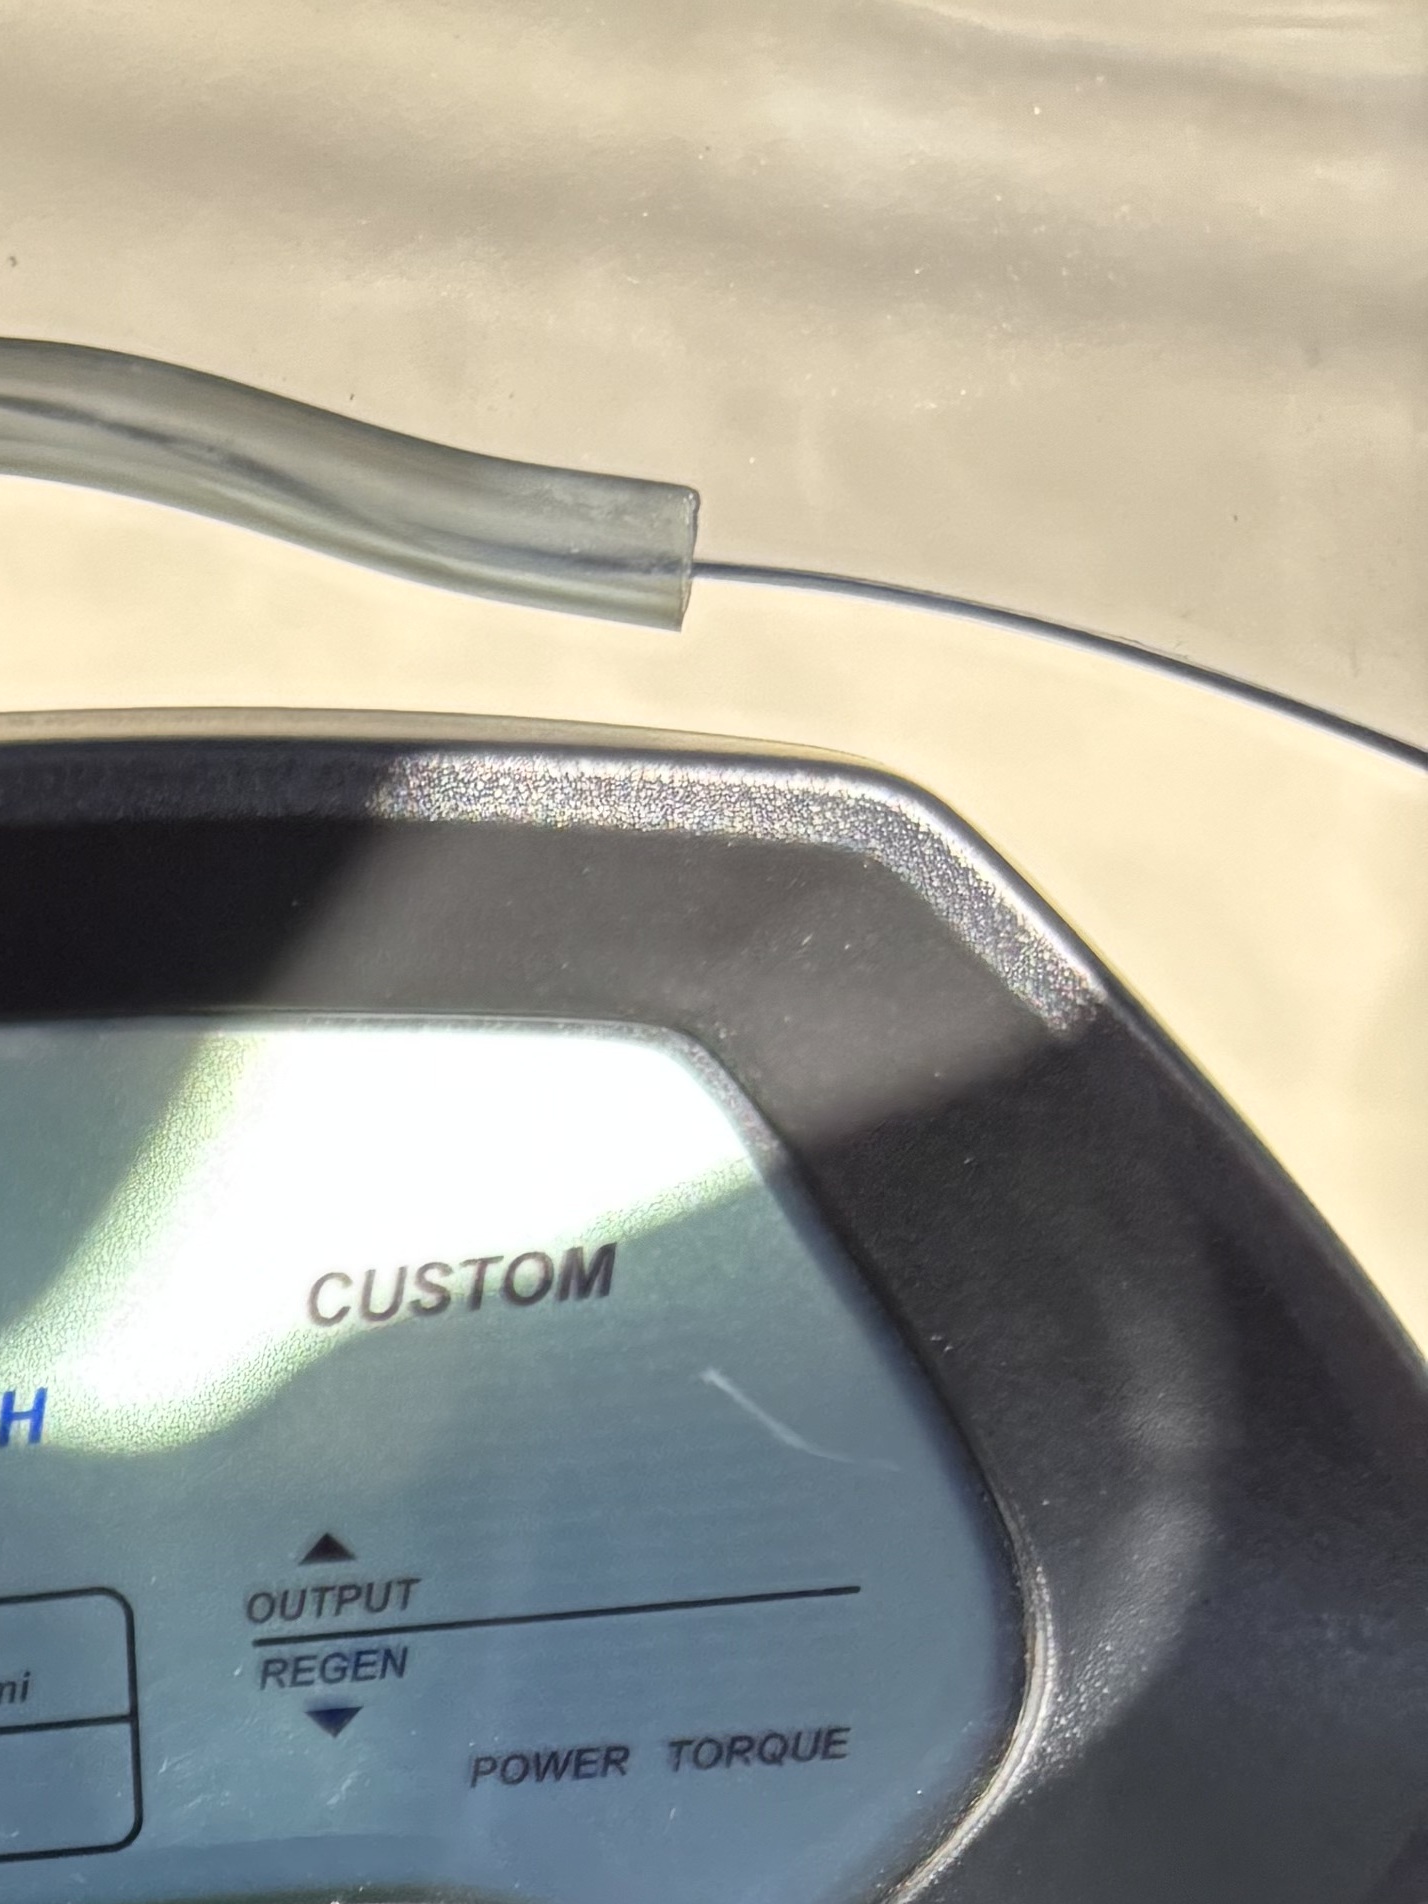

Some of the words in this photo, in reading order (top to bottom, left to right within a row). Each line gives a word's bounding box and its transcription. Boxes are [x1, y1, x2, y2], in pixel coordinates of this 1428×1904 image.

[306, 1242, 618, 1328] CUSTOM
[245, 1577, 422, 1626] OUTPUT
[259, 1646, 410, 1691] REGEN
[469, 1744, 632, 1789] POWER
[670, 1727, 852, 1772] TORQUE
